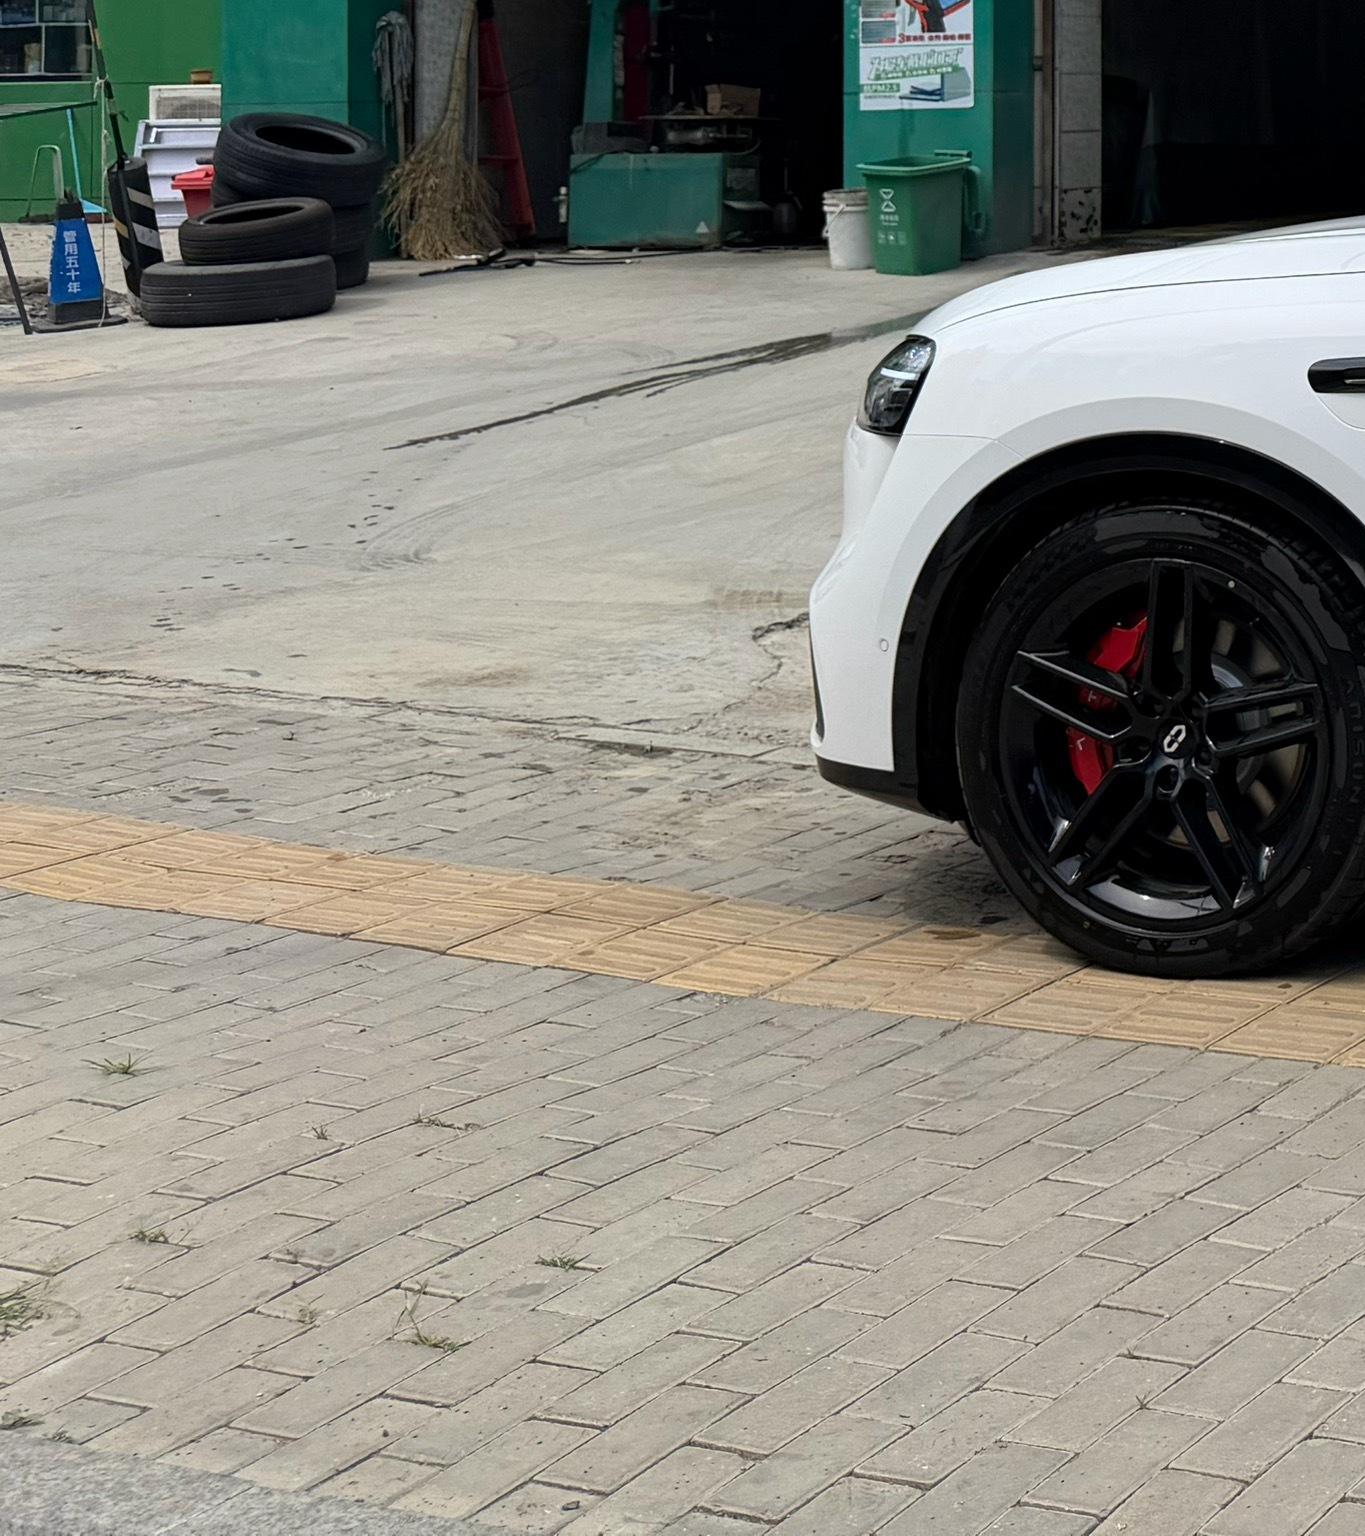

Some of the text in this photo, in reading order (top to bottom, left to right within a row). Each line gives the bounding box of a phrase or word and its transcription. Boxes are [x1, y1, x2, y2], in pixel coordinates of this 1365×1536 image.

[63, 230, 82, 294] 管用五十年
